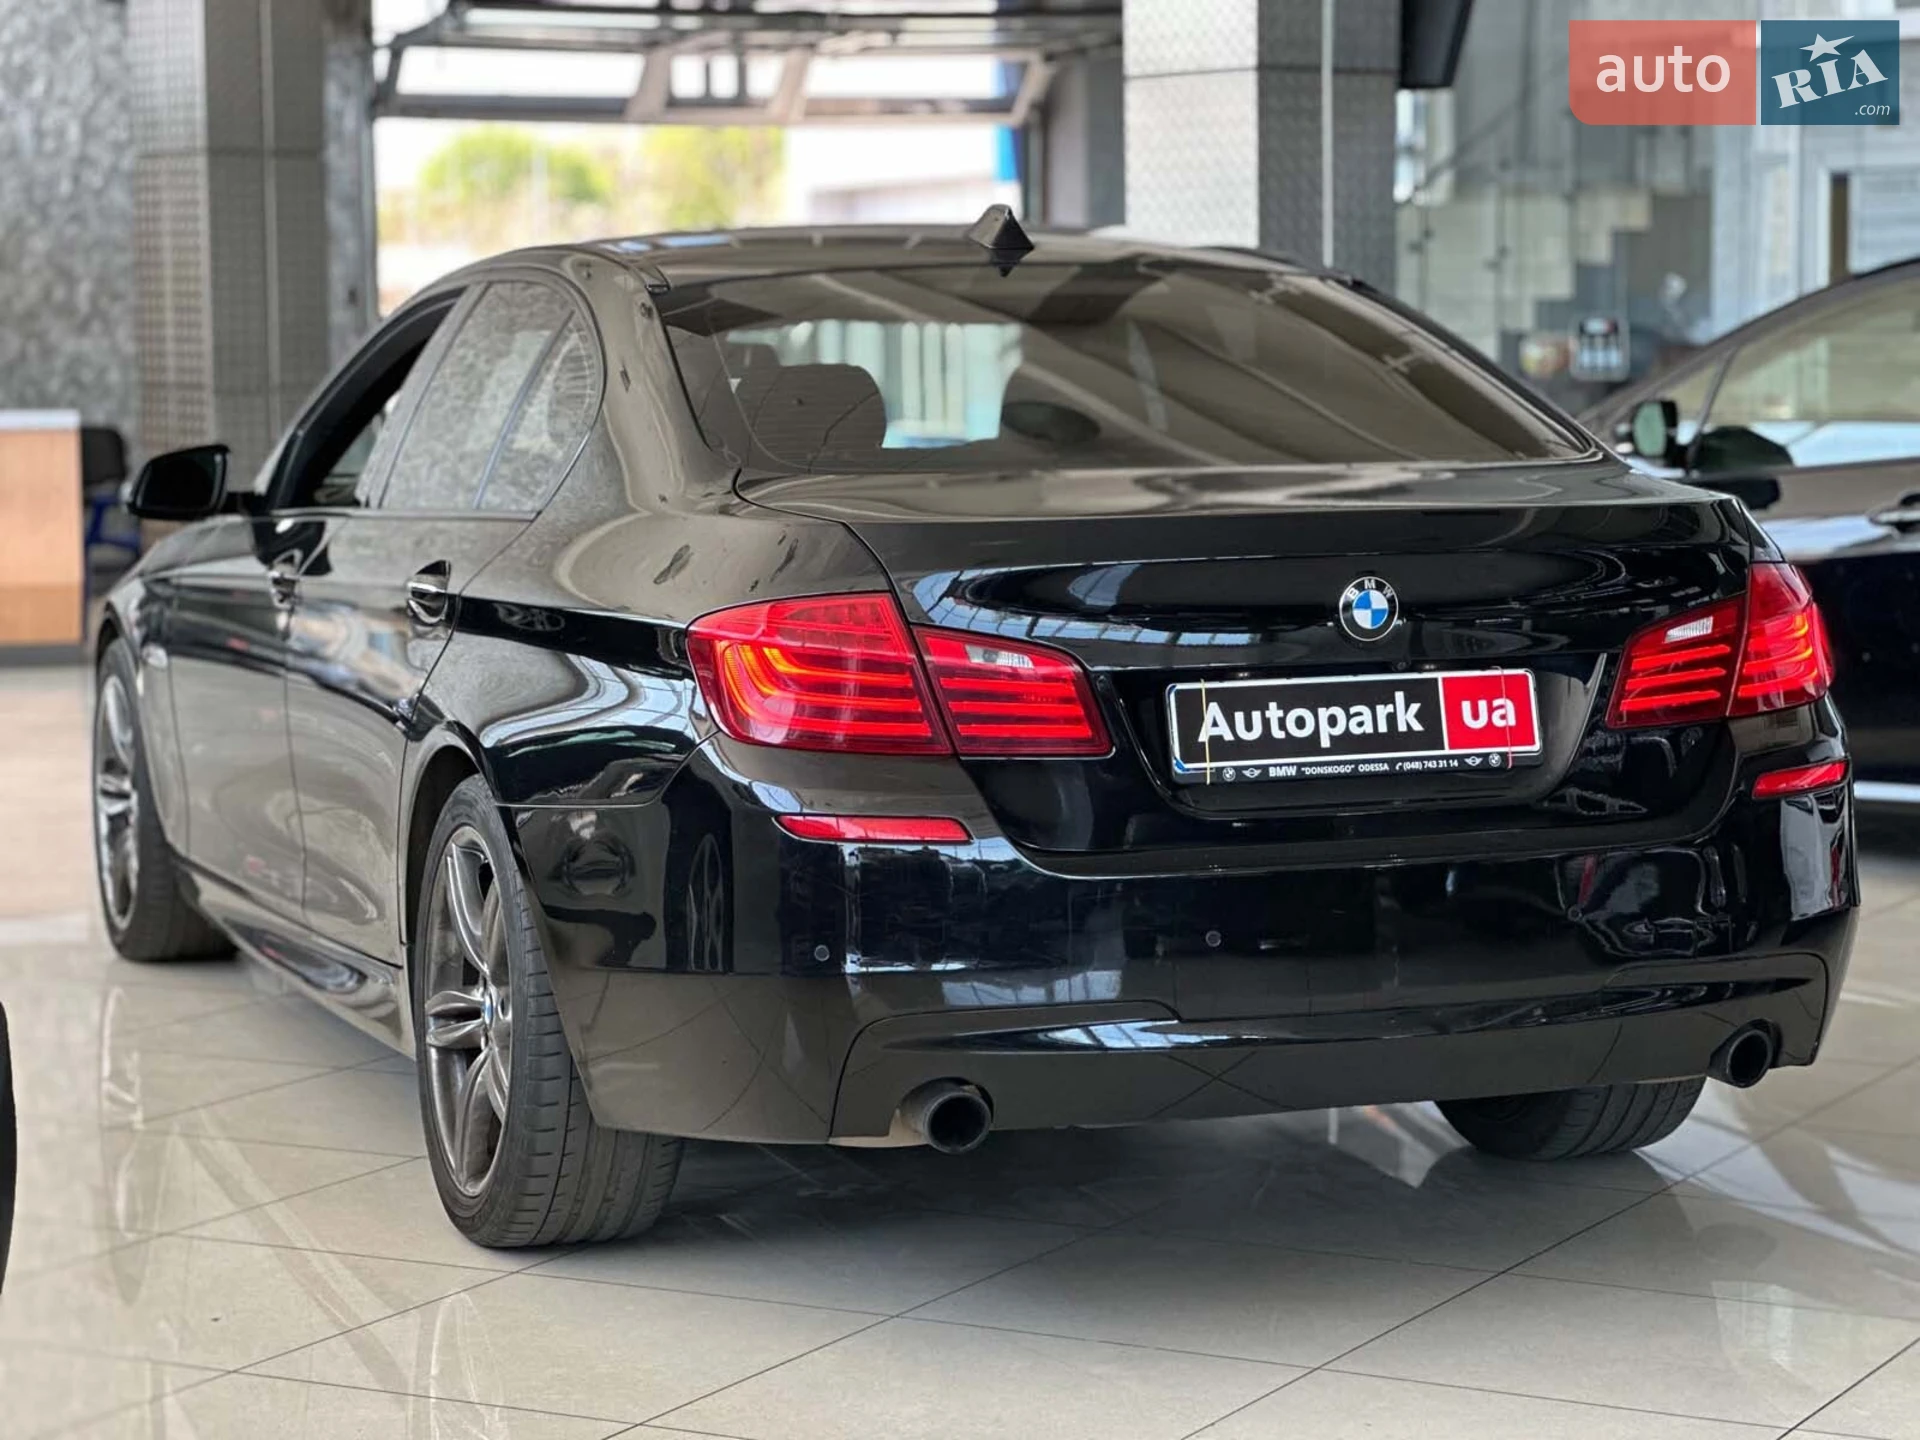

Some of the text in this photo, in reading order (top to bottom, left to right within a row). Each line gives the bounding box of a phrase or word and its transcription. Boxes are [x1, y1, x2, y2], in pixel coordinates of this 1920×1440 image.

[1347, 579, 1394, 600] BMW
[1197, 691, 1516, 749] Autopark ua
[1269, 765, 1297, 777] BMW
[1358, 762, 1390, 773] ODESSA
[1423, 760, 1437, 769] 743
[1438, 759, 1447, 768] 31
[1449, 759, 1459, 767] 14
